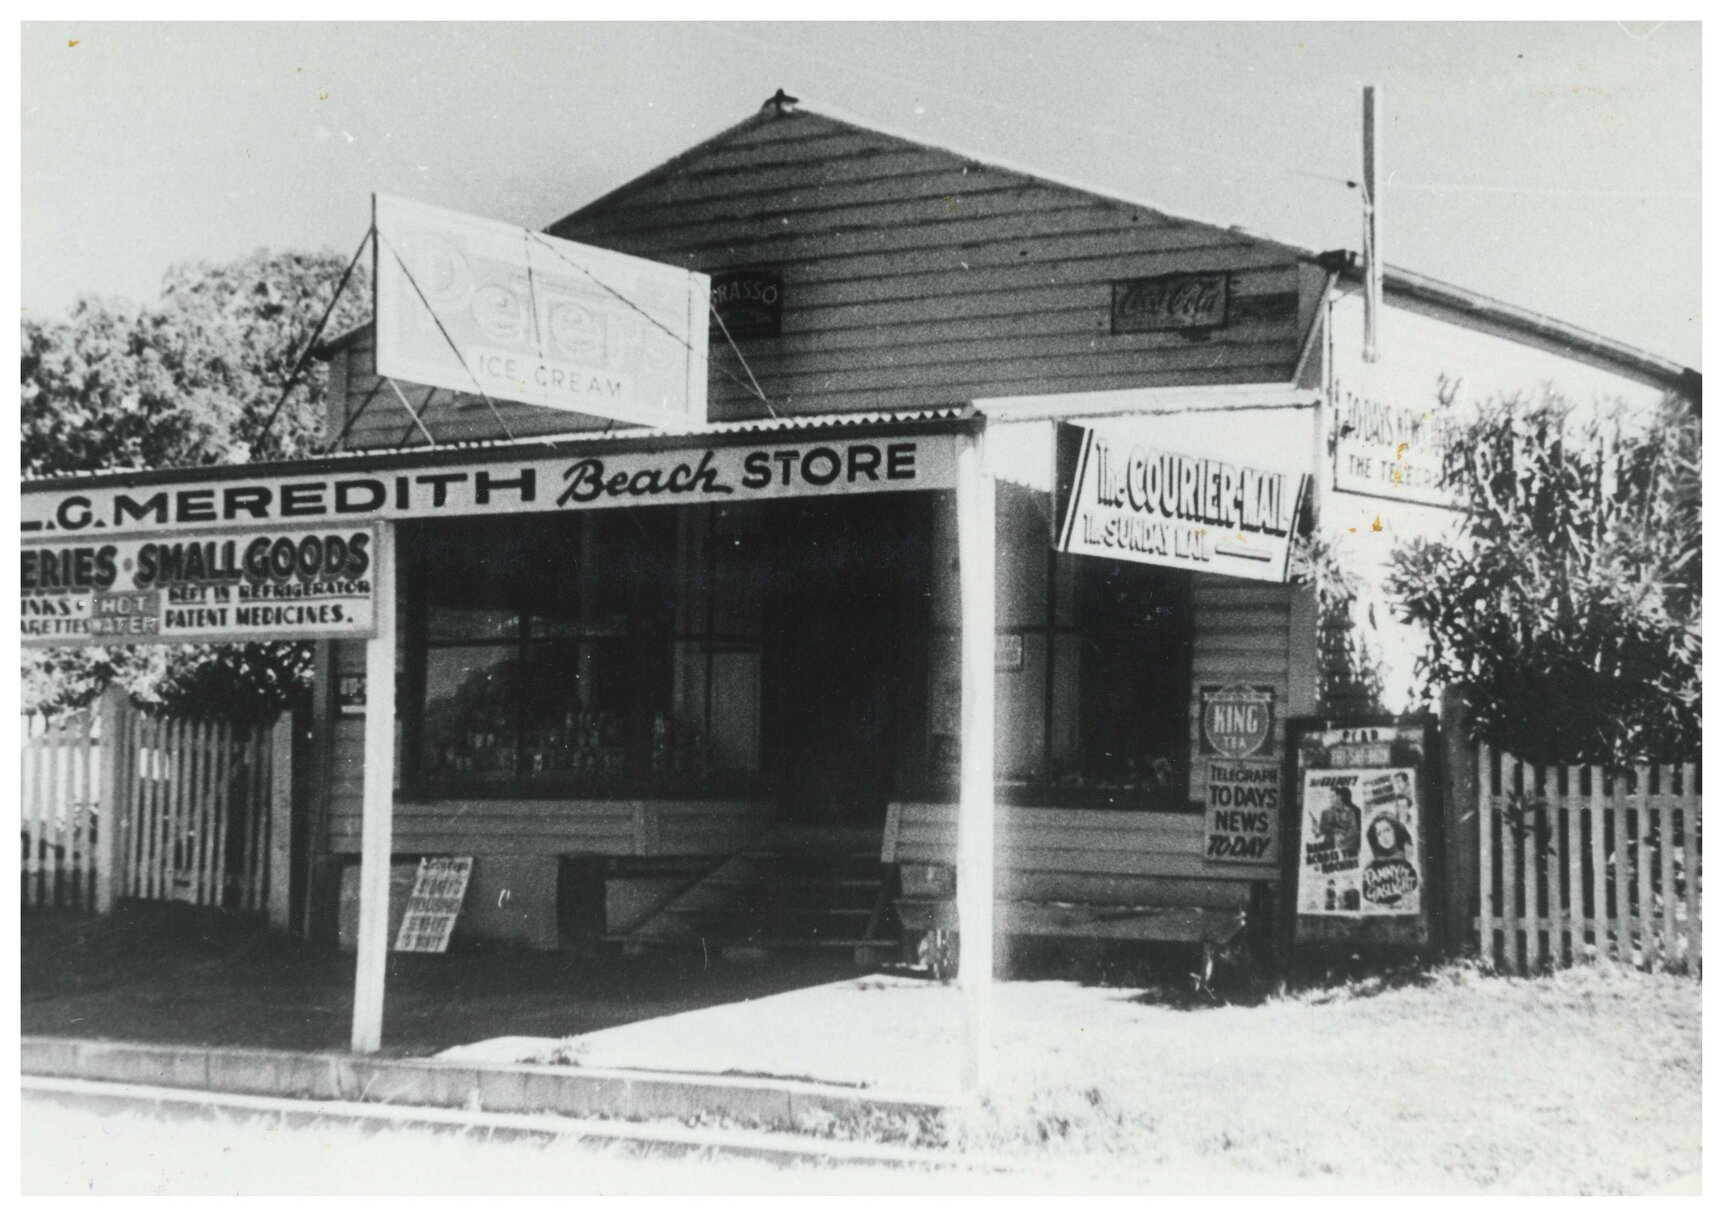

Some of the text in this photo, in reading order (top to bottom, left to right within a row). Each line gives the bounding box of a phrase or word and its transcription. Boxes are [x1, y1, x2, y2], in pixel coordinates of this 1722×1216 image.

[710, 279, 778, 305] RASSO
[477, 353, 623, 398] ICE CREAM
[1349, 454, 1371, 479] THE
[113, 469, 536, 527] MEREDITH
[556, 451, 734, 507] Beach
[741, 443, 917, 488] STORE
[1126, 444, 1289, 538] COURIER-MAIL
[1103, 514, 1171, 557] SUNDAY
[1173, 523, 1210, 562] MAIL
[214, 585, 231, 600] IN
[238, 580, 371, 600] REFRIGERATOR
[101, 597, 148, 614] HOT
[165, 604, 354, 628] PATENT MEDICINES.
[1213, 705, 1258, 733] KING
[1223, 736, 1247, 749] TEA
[1211, 765, 1278, 783] TELEGRAPH
[1215, 810, 1269, 832] NEWS
[1206, 834, 1272, 858] TODAY
